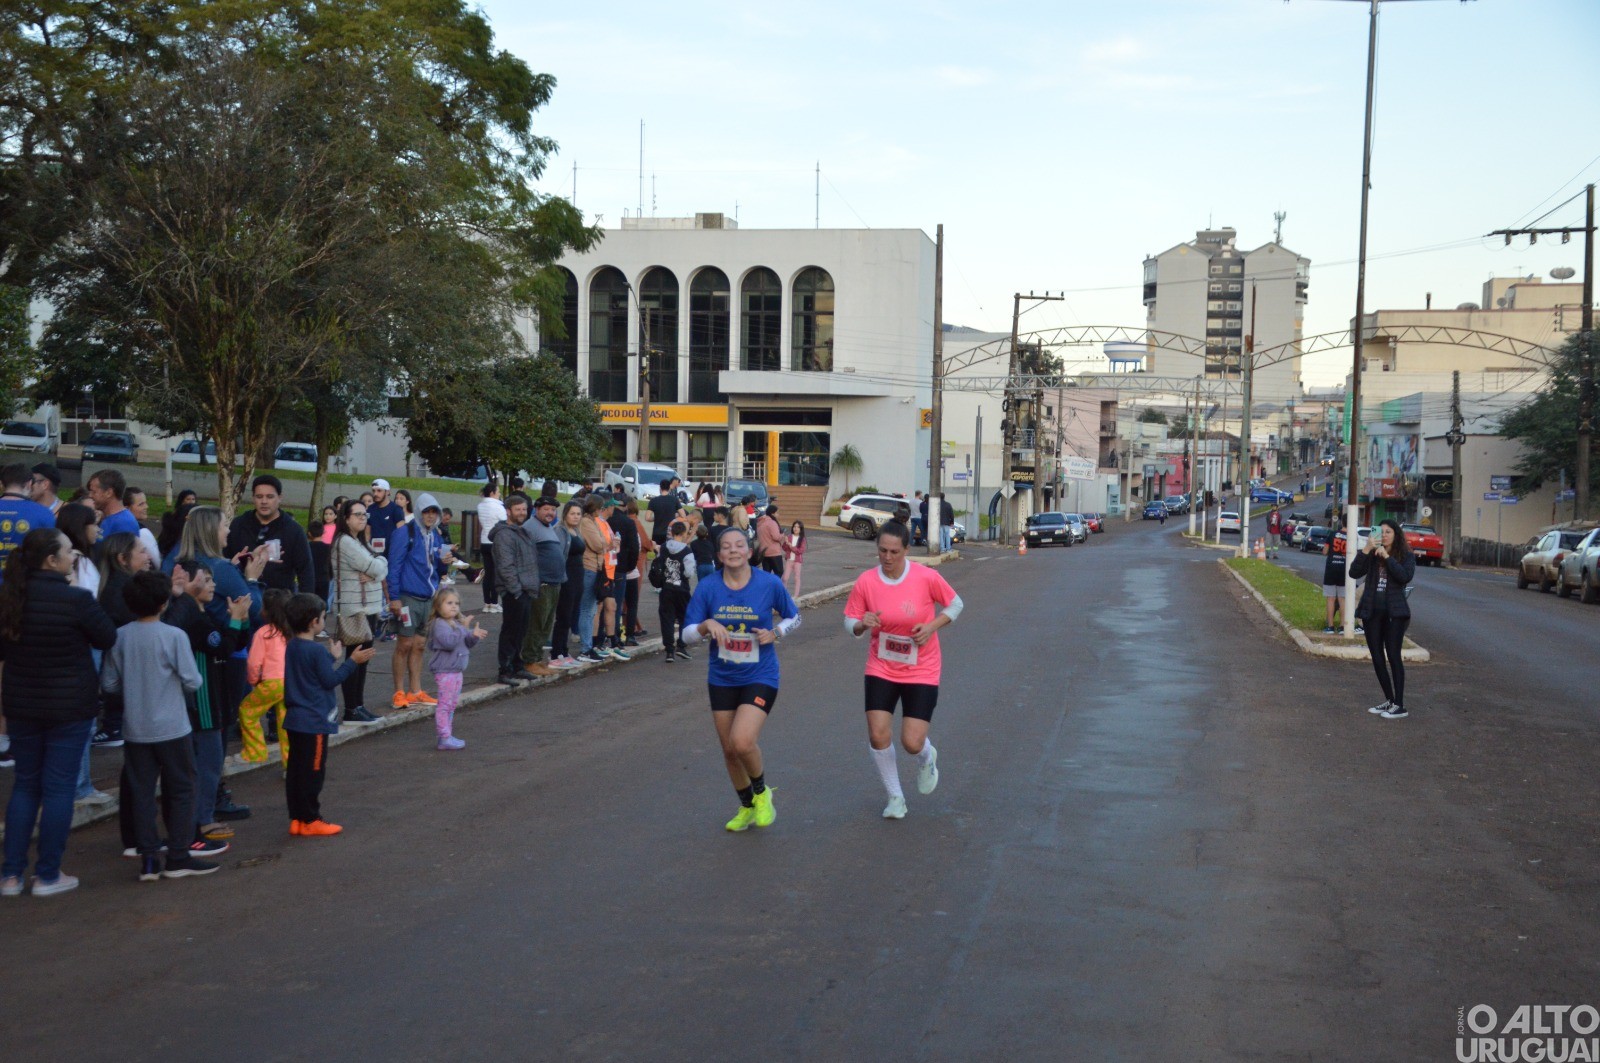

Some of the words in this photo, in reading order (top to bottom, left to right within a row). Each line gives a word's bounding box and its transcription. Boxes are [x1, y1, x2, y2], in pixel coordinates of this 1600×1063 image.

[622, 410, 635, 418] DO
[636, 408, 669, 418] BASIL
[727, 605, 753, 613] RÚSTICA
